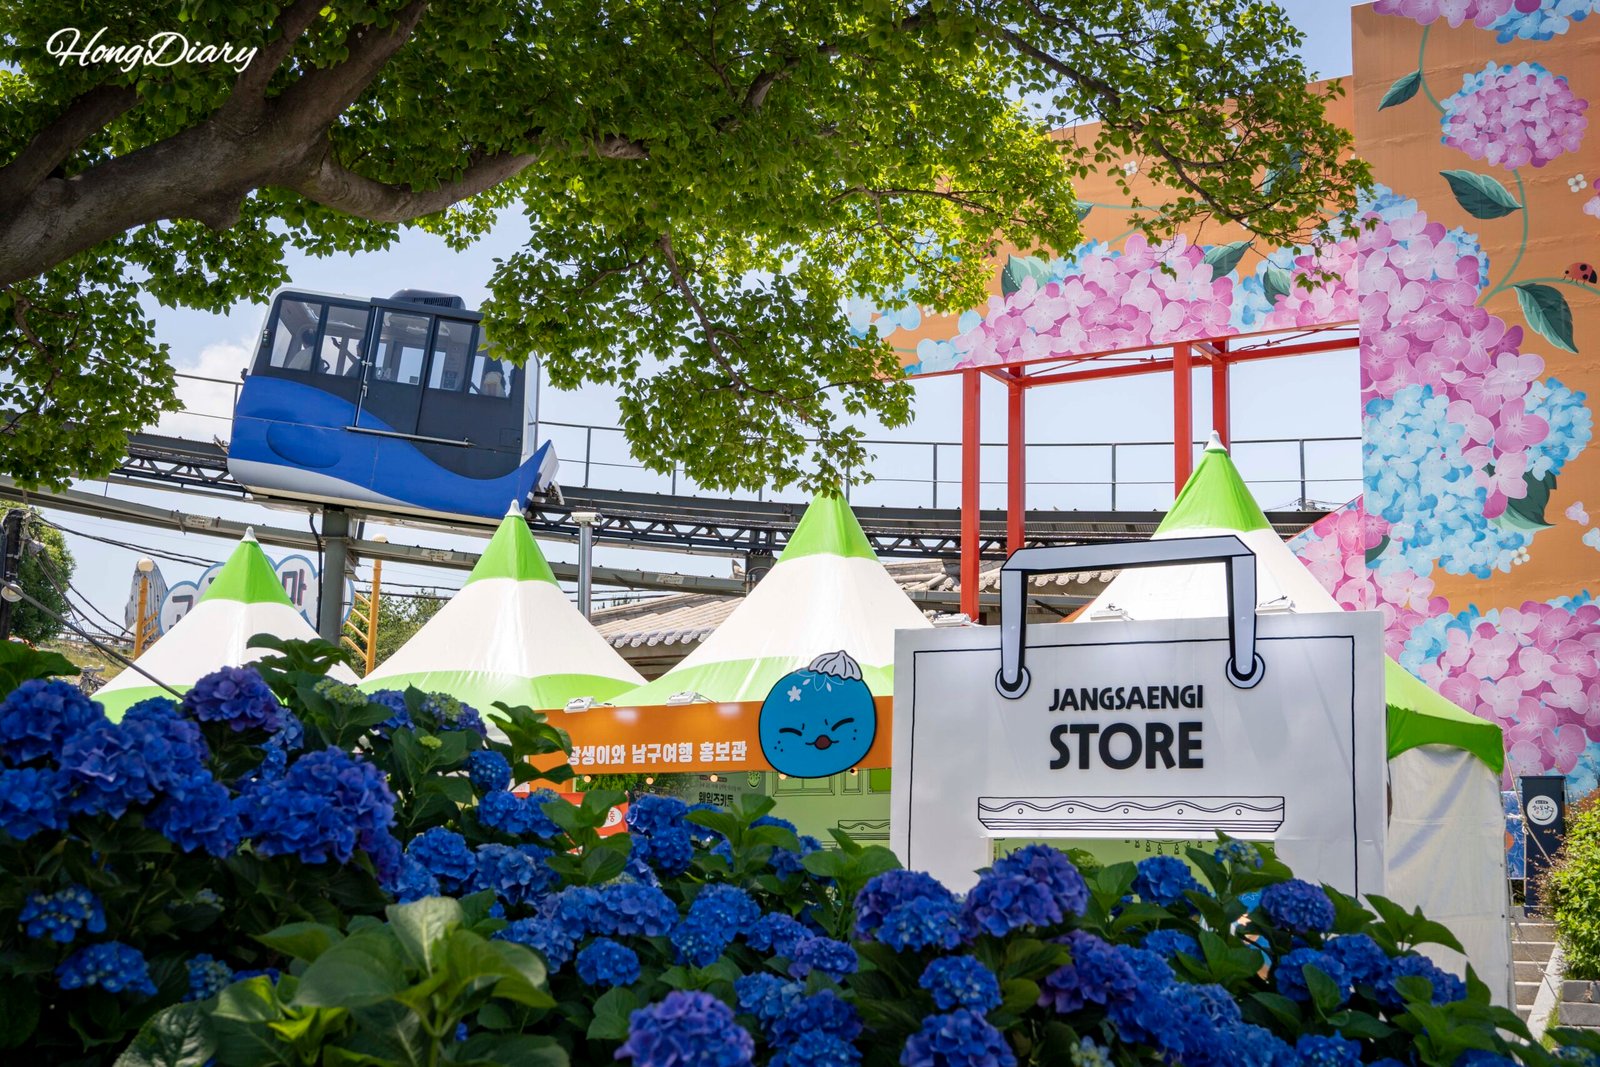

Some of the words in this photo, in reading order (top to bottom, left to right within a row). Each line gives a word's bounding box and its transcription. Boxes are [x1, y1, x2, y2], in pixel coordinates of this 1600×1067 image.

[1049, 685, 1204, 711] JANGSAENGI
[567, 744, 626, 765] 장생이와
[632, 742, 692, 764] 남구여행
[699, 740, 747, 762] 홍보관
[1049, 721, 1204, 770] STORE
